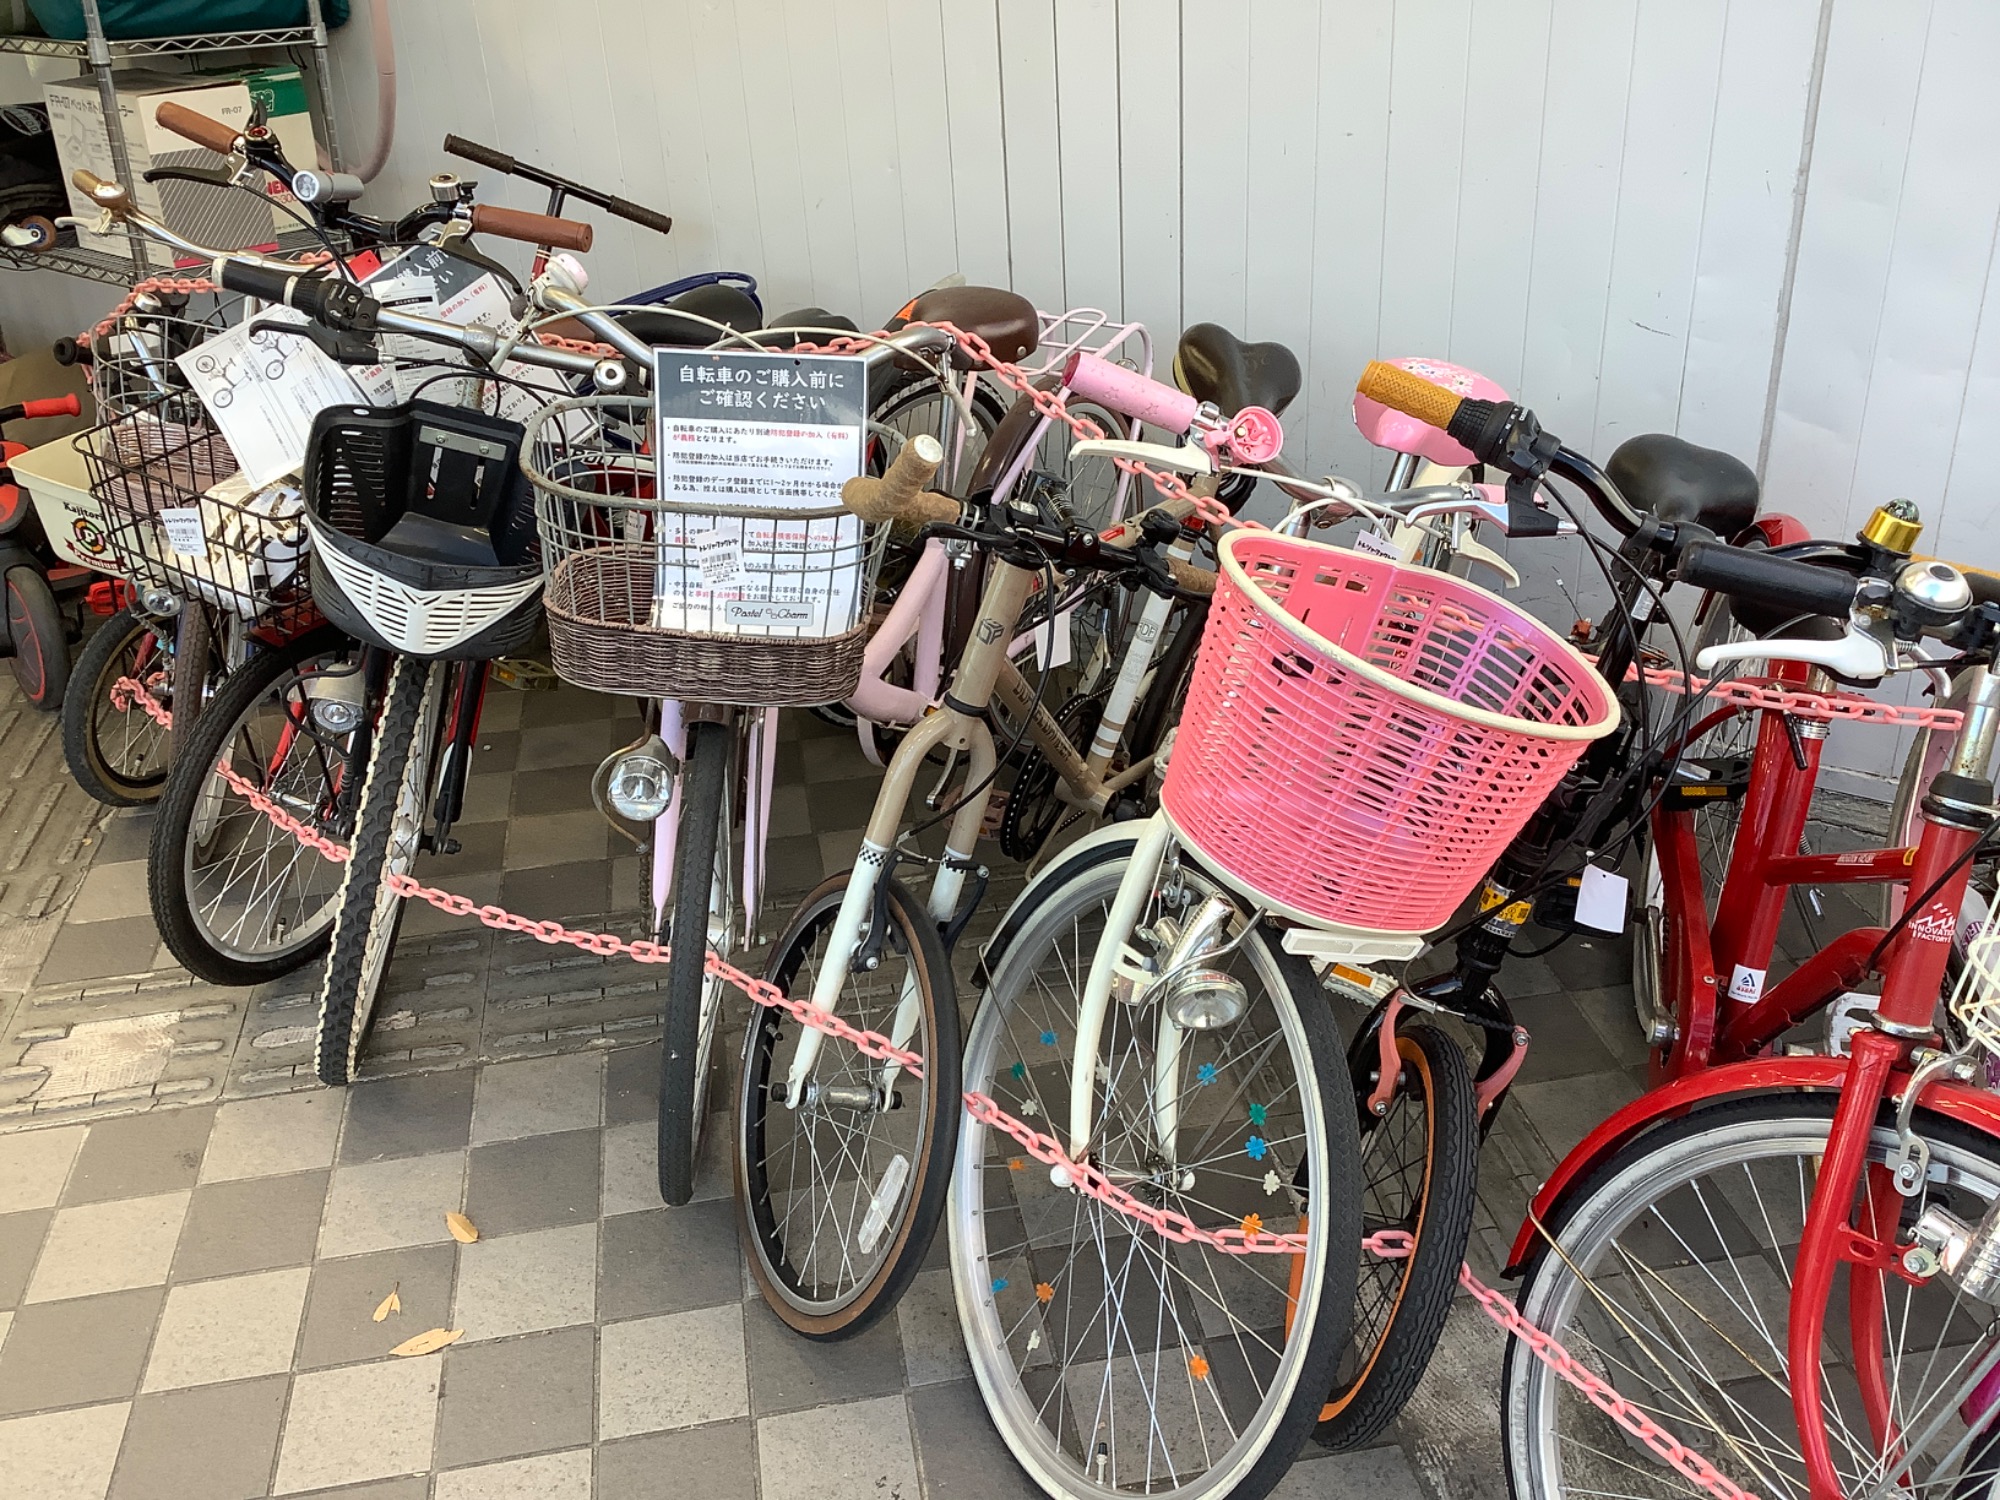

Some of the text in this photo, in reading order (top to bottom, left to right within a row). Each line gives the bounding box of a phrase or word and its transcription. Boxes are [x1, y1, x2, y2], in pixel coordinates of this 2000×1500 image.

[679, 364, 845, 389] 自転車のご購入前に
[699, 388, 826, 410] ご確認ください
[731, 606, 808, 619] Pastel Charm
